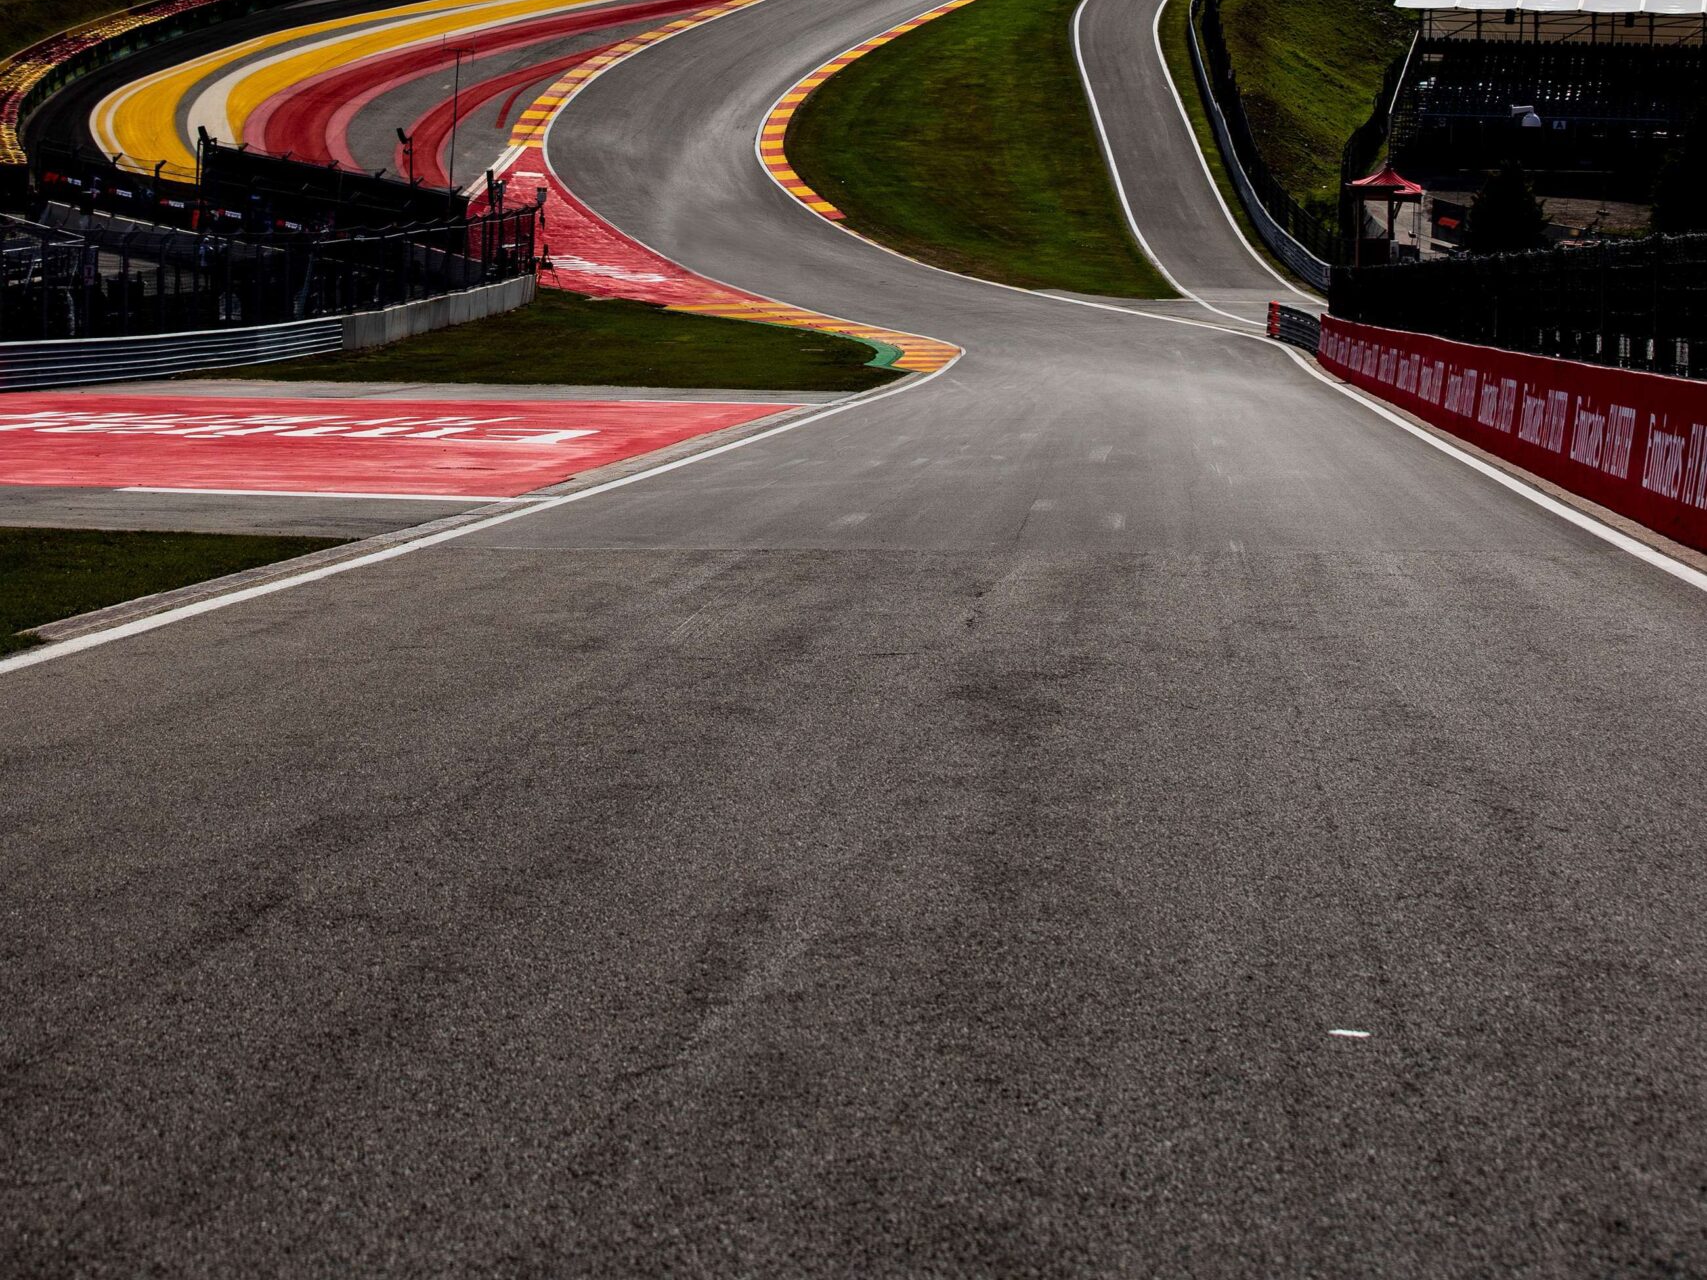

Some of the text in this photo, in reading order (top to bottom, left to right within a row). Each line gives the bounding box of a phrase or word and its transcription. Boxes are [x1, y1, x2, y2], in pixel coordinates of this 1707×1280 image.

[322, 416, 526, 426] FLY
[1569, 395, 1605, 469] Emirates
[1642, 412, 1685, 499] Emirates
